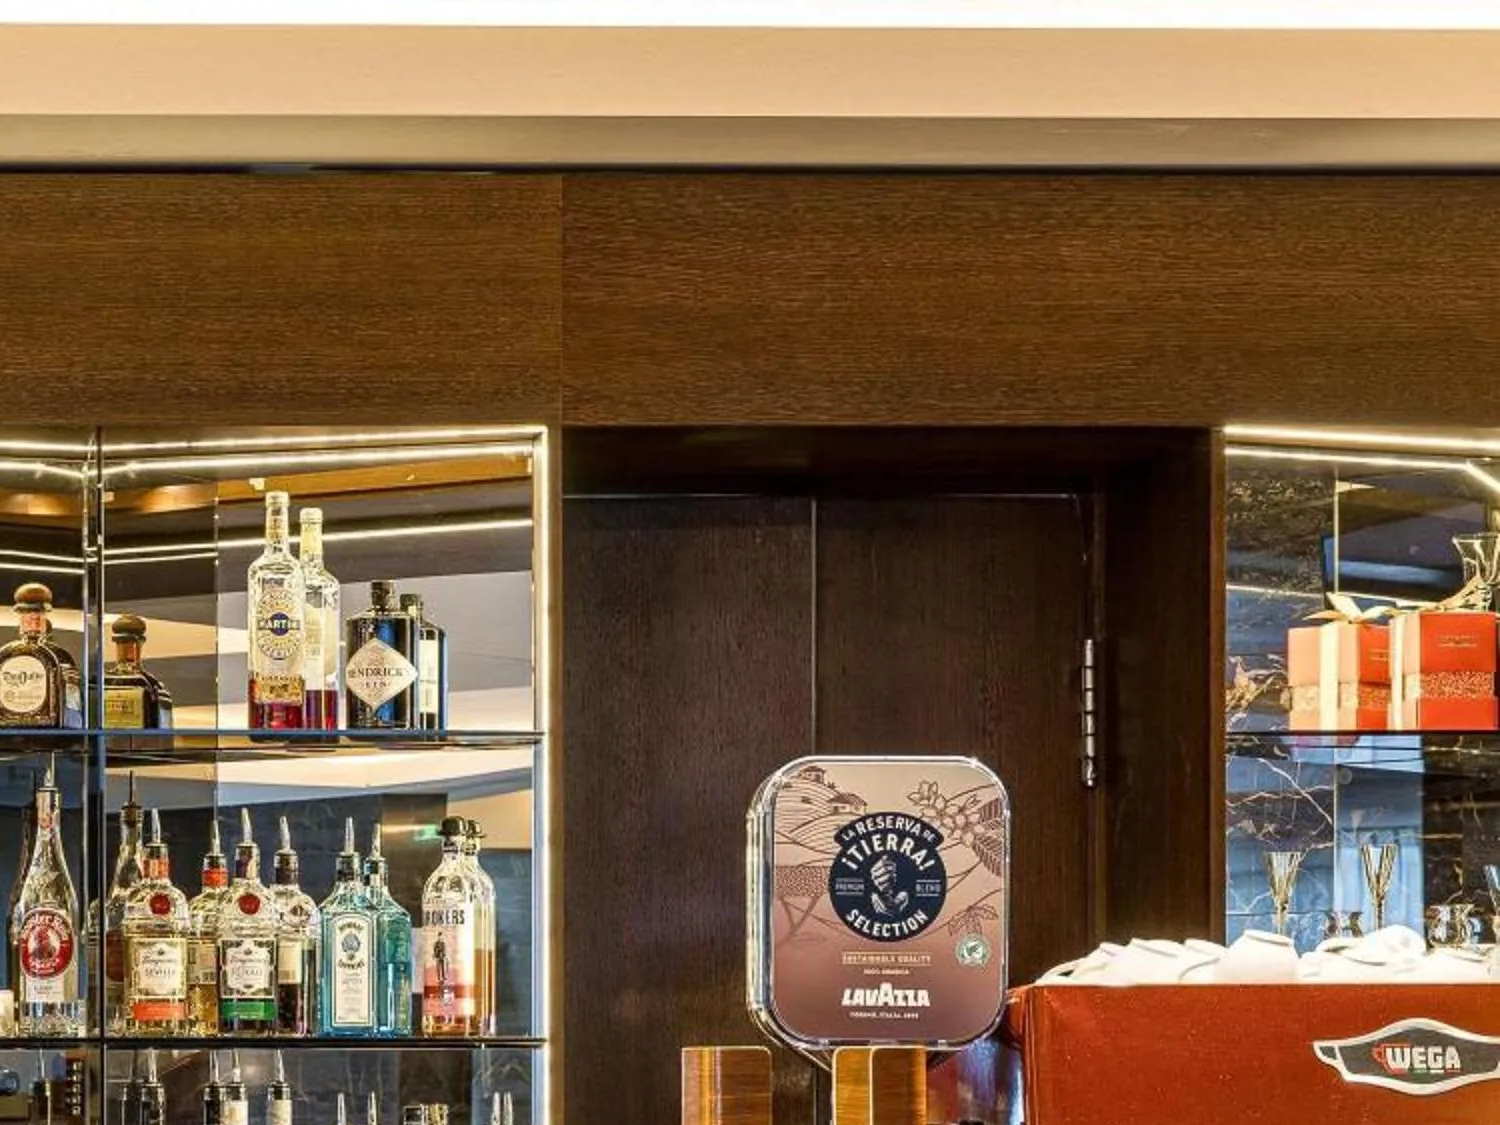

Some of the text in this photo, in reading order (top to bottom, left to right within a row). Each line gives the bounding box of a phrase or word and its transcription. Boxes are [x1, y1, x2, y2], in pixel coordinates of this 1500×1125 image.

[842, 816, 936, 842] LA RESERVA DE
[846, 909, 928, 937] SELECTION
[842, 982, 931, 1007] LAVAZZA
[1385, 1045, 1461, 1069] WEGA
